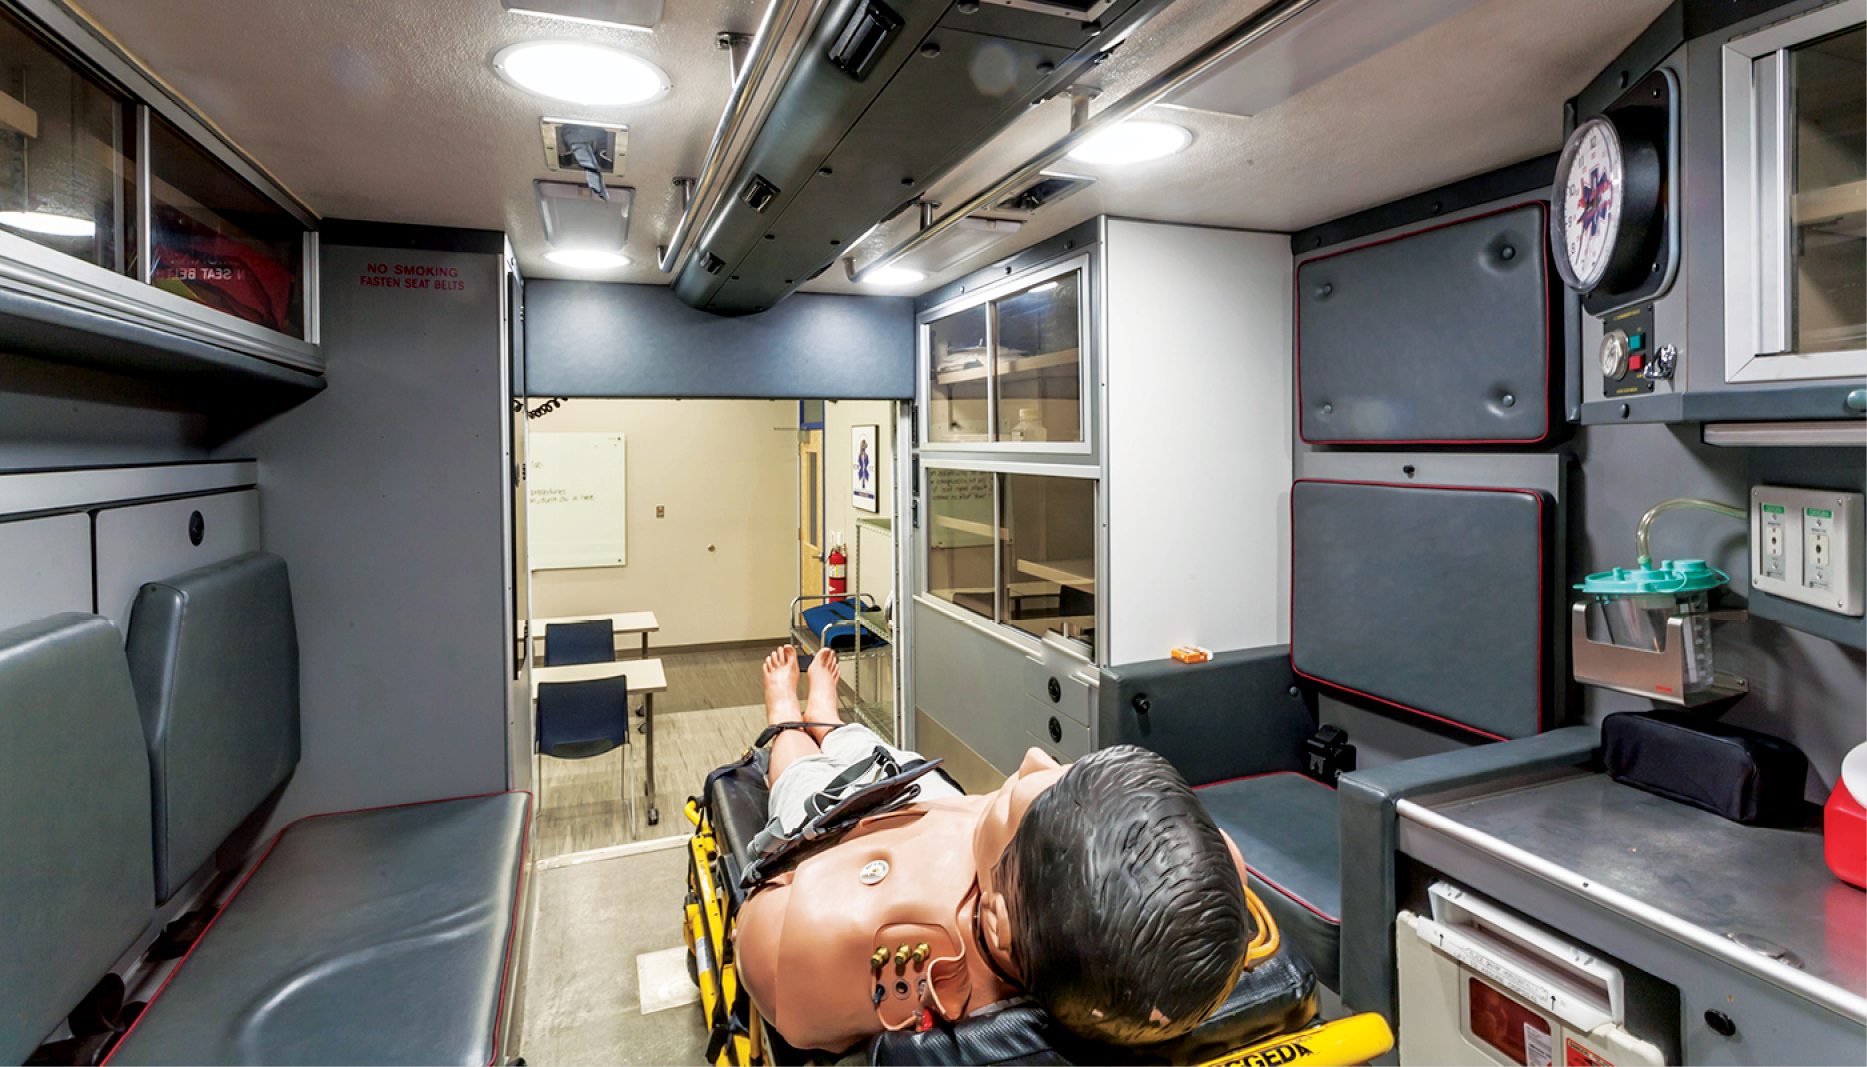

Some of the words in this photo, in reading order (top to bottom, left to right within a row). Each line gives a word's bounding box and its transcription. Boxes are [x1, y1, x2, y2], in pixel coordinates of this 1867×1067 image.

[367, 263, 388, 274] NO
[394, 264, 459, 278] SMOKING
[360, 275, 401, 288] FASTEN
[404, 278, 431, 289] SEAT
[433, 280, 465, 292] BELTS
